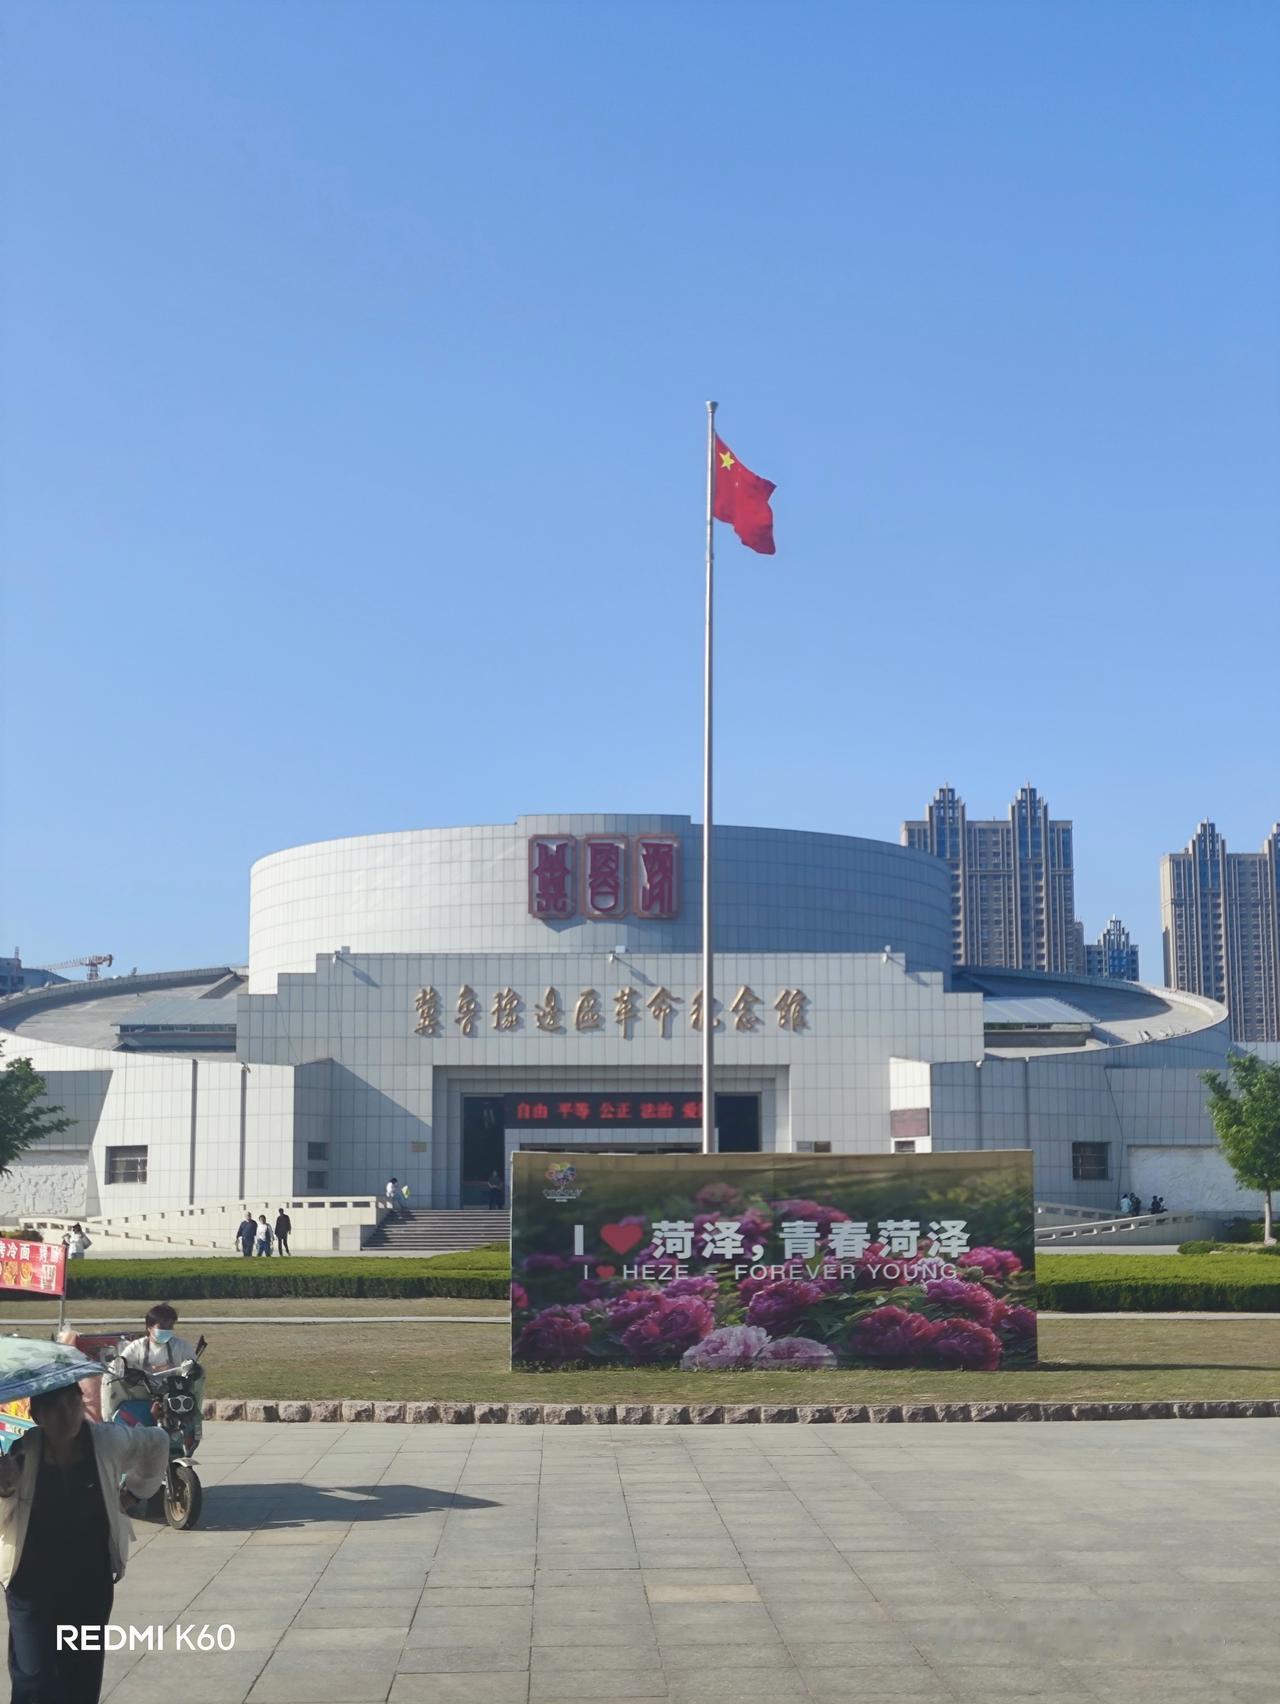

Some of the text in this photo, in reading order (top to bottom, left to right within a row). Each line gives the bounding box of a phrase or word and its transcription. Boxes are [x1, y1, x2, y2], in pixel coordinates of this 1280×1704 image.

[516, 1101, 549, 1120] 自由
[557, 1101, 591, 1120] 平等
[599, 1101, 632, 1120] 公正
[573, 1224, 585, 1256] I
[583, 1264, 588, 1280] I
[622, 1264, 689, 1280] HEZE
[735, 1264, 856, 1280] FOREVER
[866, 1263, 957, 1280] YOUNG
